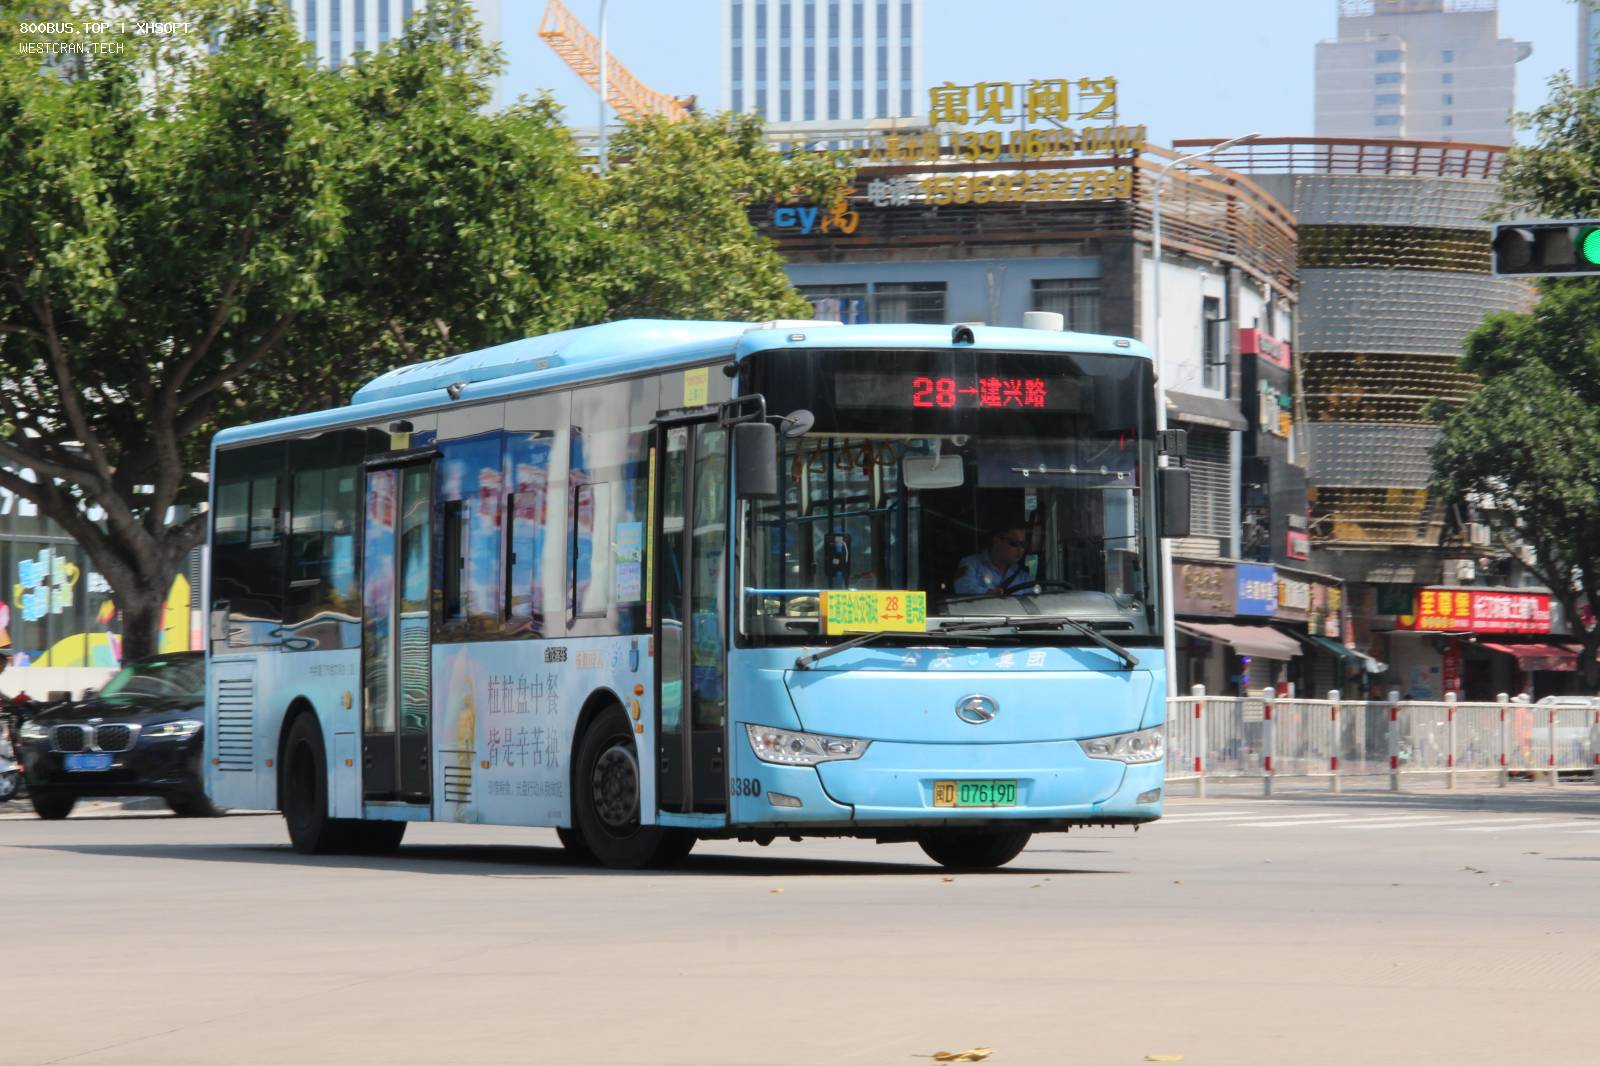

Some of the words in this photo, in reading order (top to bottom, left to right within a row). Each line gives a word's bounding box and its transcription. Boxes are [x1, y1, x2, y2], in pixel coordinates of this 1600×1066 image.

[951, 130, 1002, 161] 139
[912, 376, 957, 408] 28
[979, 376, 1047, 408] 建兴路
[885, 595, 899, 612] 28
[487, 673, 560, 715] 粒粒盘中餐
[487, 727, 561, 769] 皆是辛苦换
[961, 783, 1015, 803] 07619D
